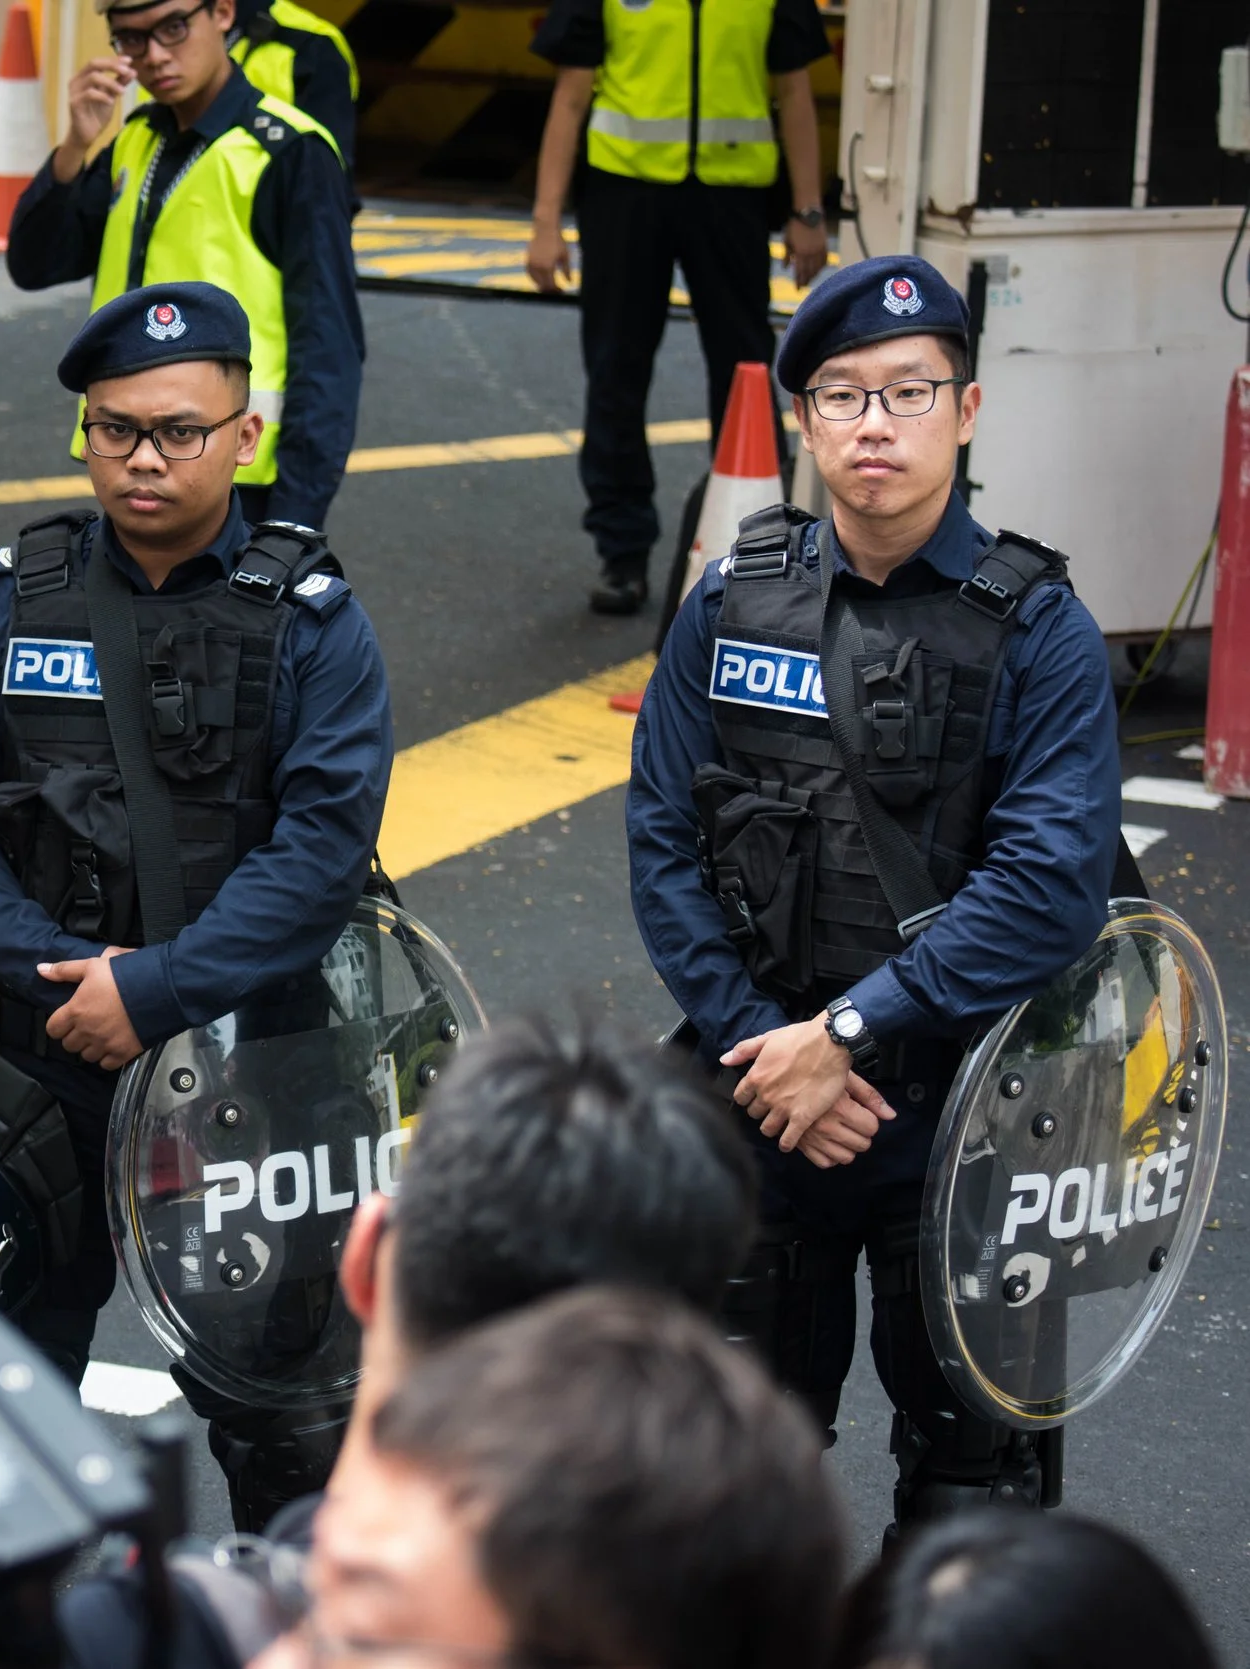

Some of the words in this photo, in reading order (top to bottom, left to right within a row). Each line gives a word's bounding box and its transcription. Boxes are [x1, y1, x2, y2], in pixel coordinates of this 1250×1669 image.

[203, 1126, 412, 1234] POLIC
[1000, 1143, 1191, 1245] POLICE
[186, 1226, 199, 1238] CE
[985, 1235, 997, 1247] CE
